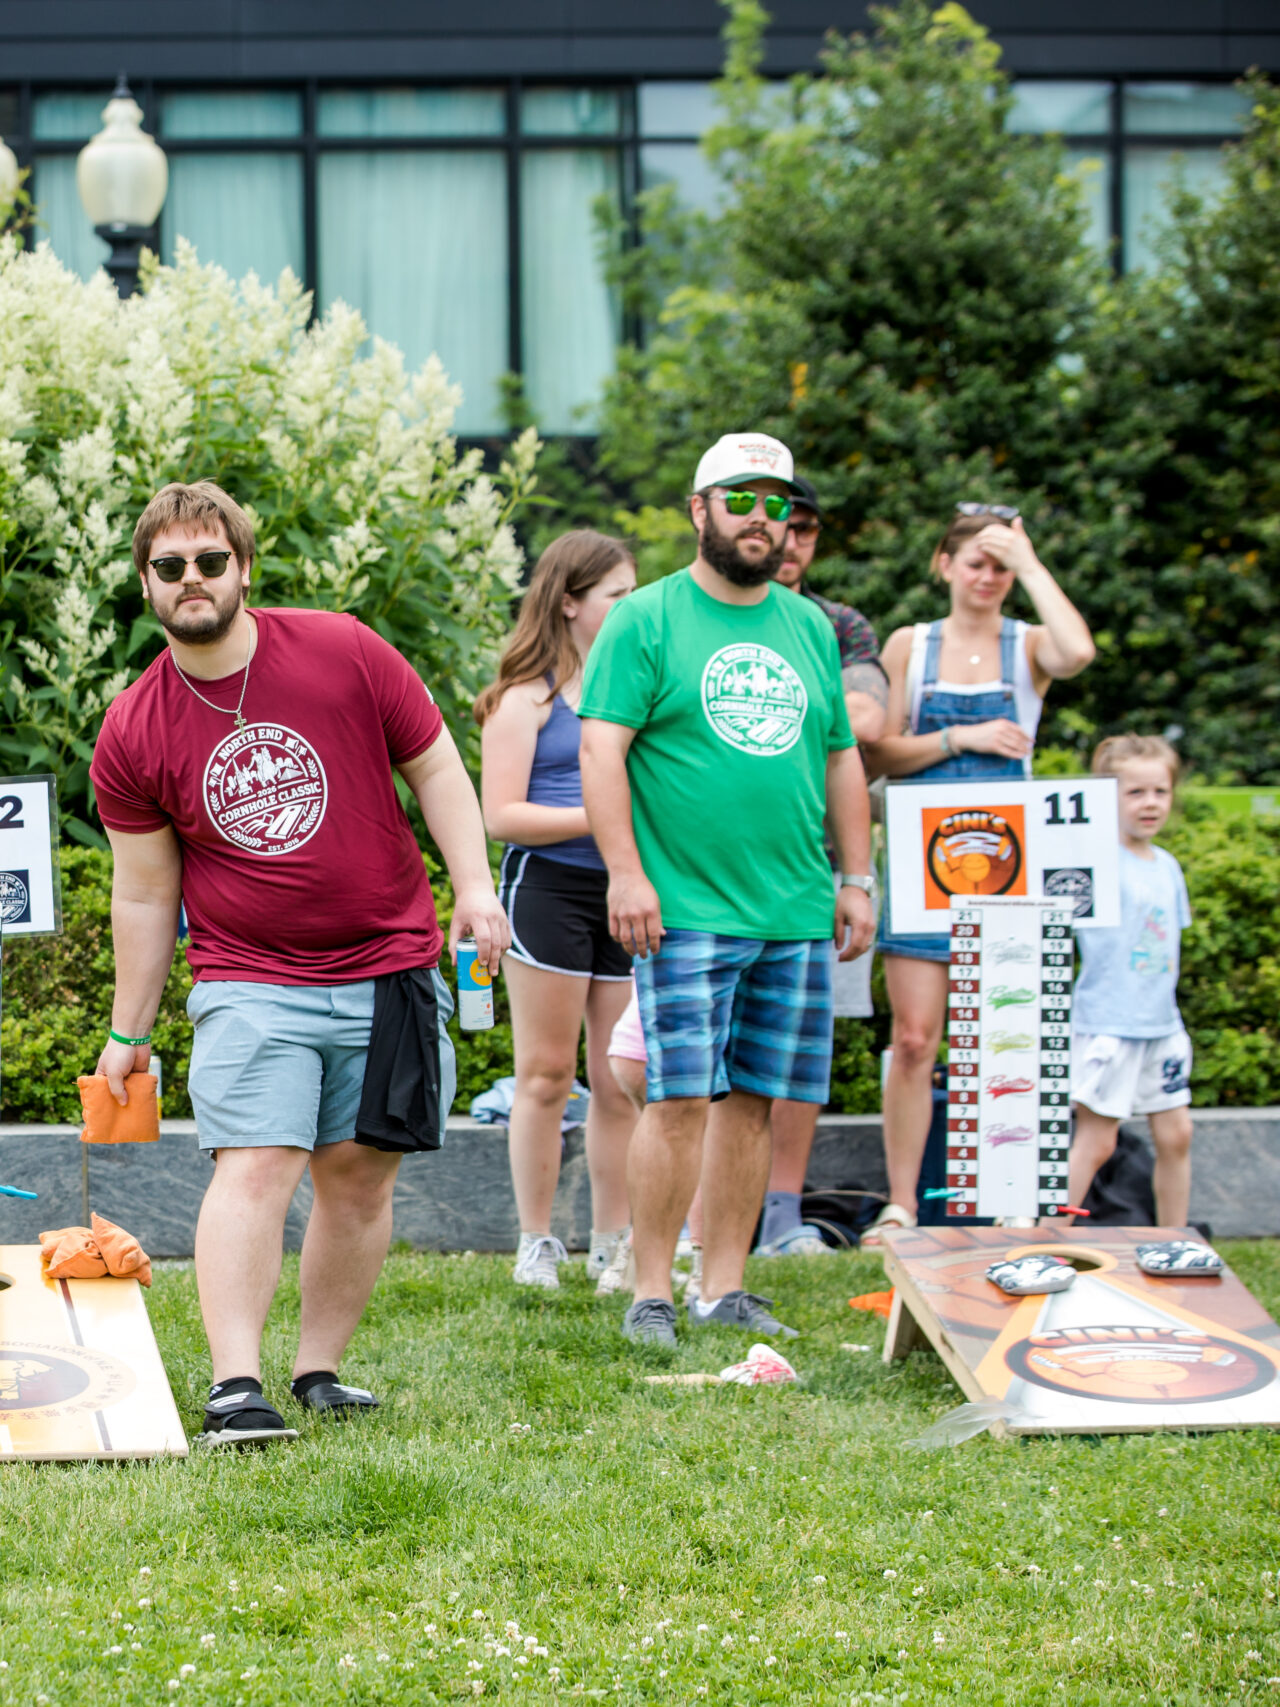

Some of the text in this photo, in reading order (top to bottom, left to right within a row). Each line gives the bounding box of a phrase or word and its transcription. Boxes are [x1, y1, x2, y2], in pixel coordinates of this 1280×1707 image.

[217, 728, 283, 760] NORTH END
[218, 781, 322, 826] CORNHOLE CLASSIC
[257, 785, 277, 798] 2026
[1044, 791, 1091, 825] 11
[938, 812, 1007, 837] CINI'S
[1028, 1327, 1214, 1347] CINI'S
